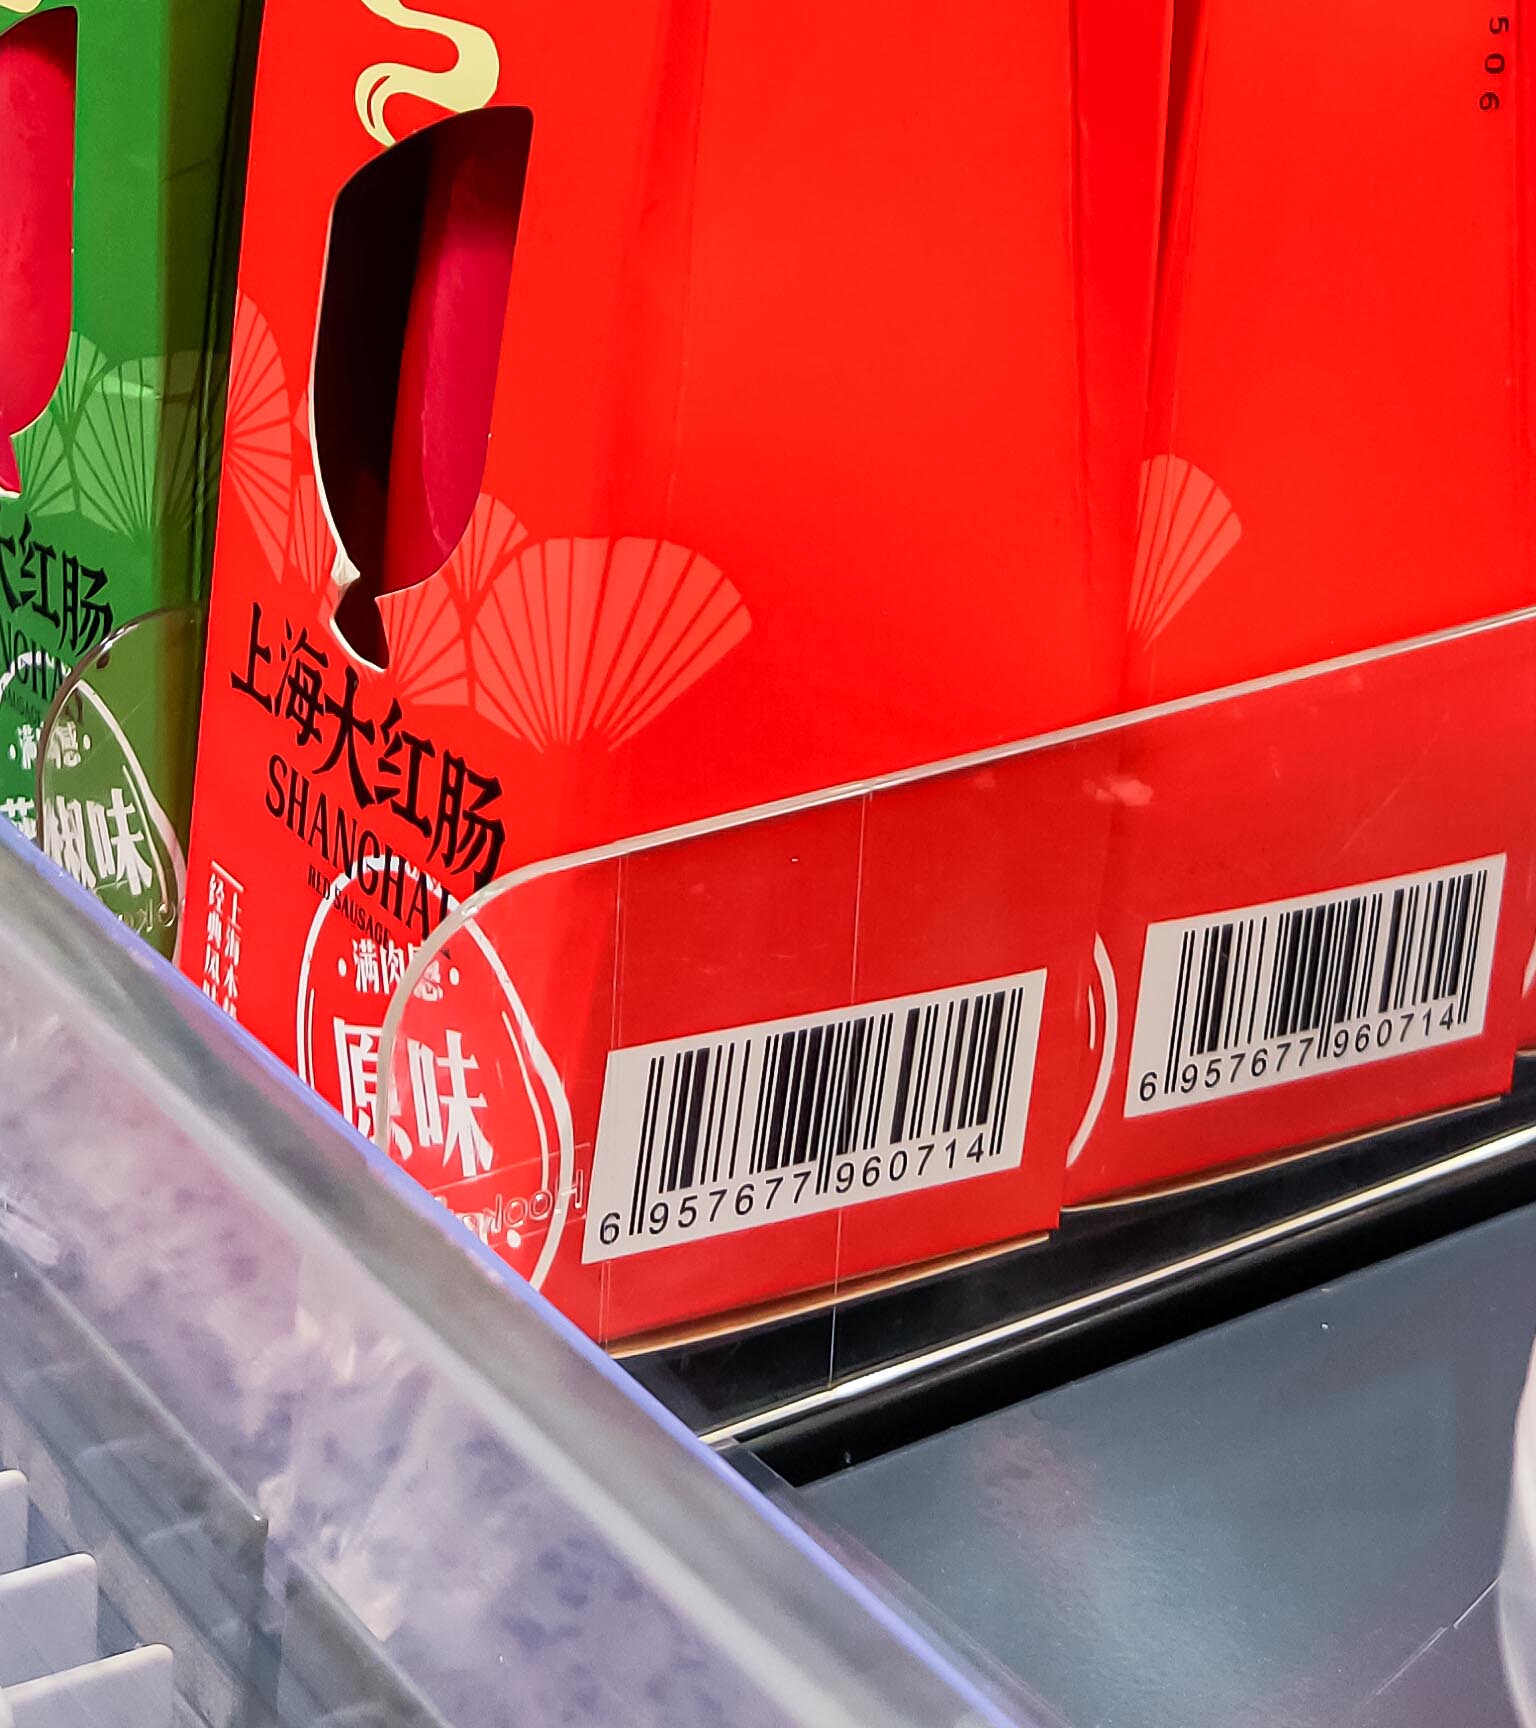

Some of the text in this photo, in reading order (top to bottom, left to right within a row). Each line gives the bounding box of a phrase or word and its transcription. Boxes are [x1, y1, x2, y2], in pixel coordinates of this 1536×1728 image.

[230, 600, 506, 894] 上海大红肠
